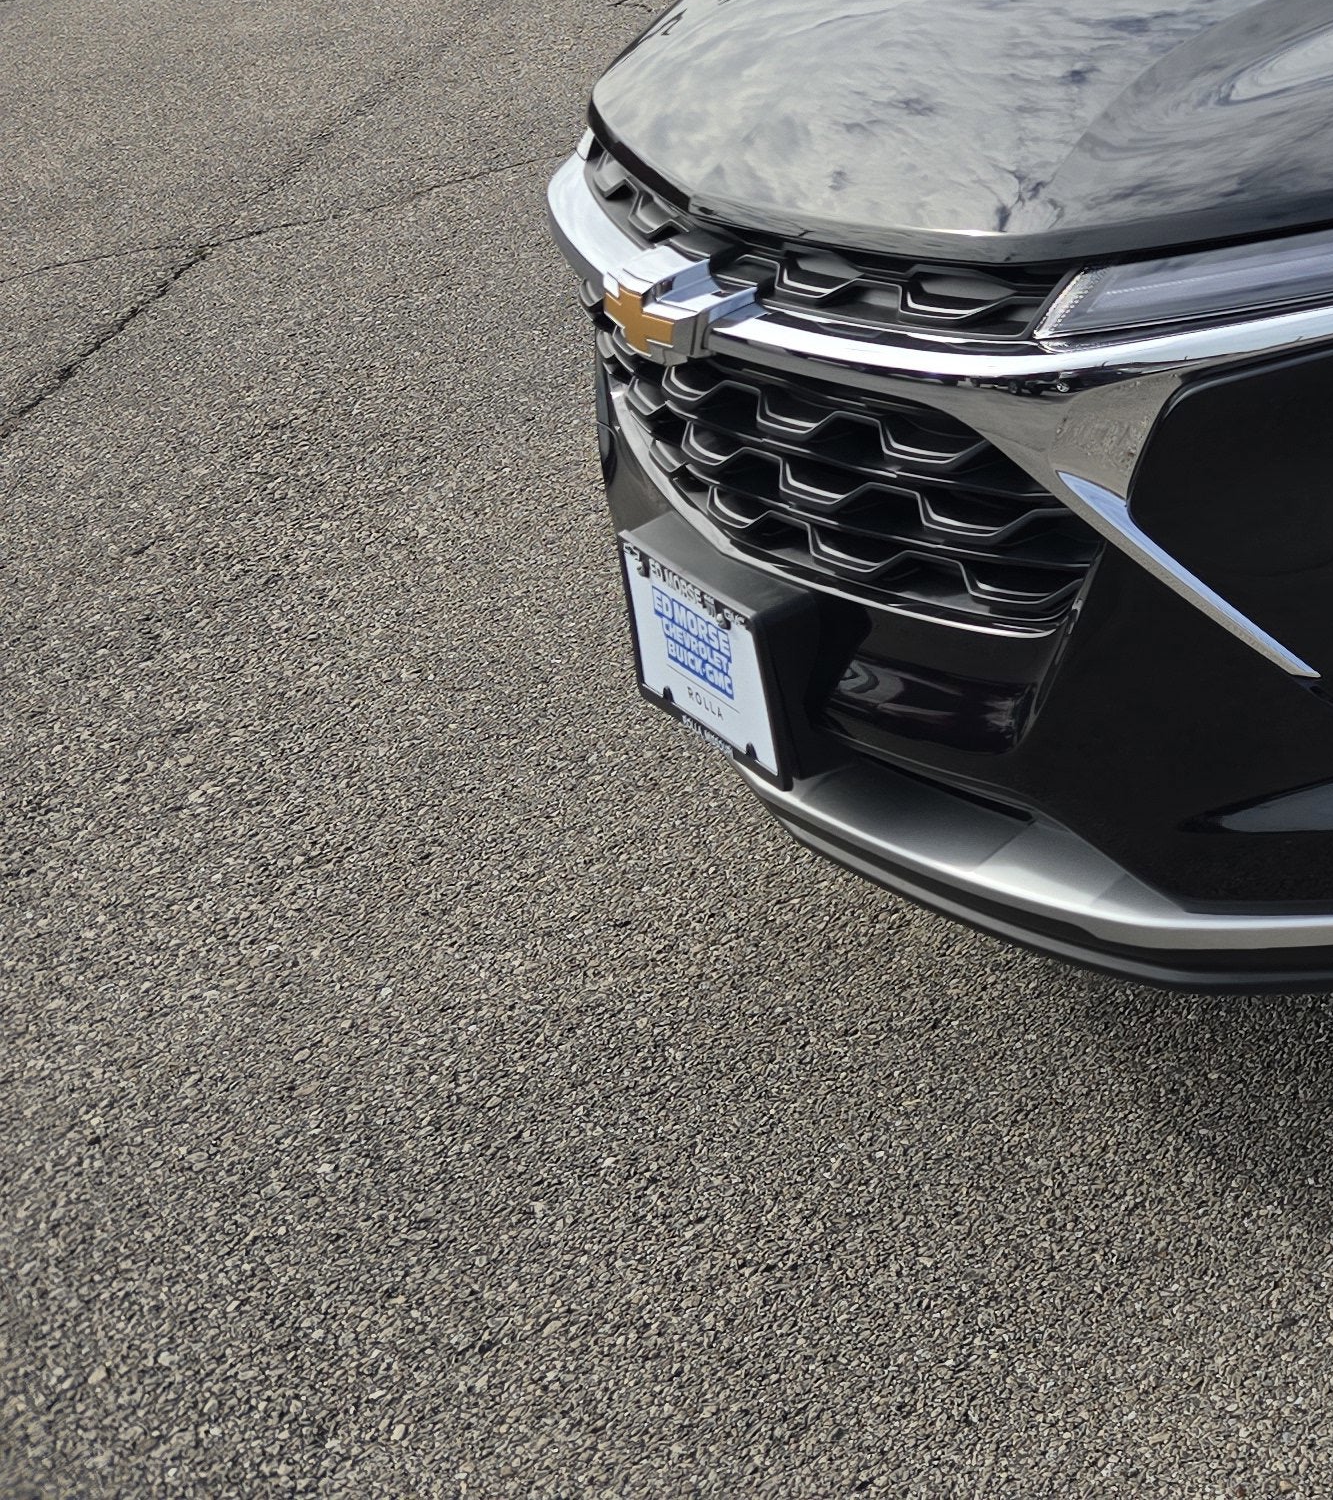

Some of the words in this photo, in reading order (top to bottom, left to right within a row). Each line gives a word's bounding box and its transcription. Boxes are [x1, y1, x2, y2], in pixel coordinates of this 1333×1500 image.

[662, 566, 702, 606] MORSE
[652, 585, 674, 621] ED
[672, 597, 732, 663] MORSE
[662, 616, 730, 676] CHEVROLET
[686, 685, 725, 721] ROLLA
